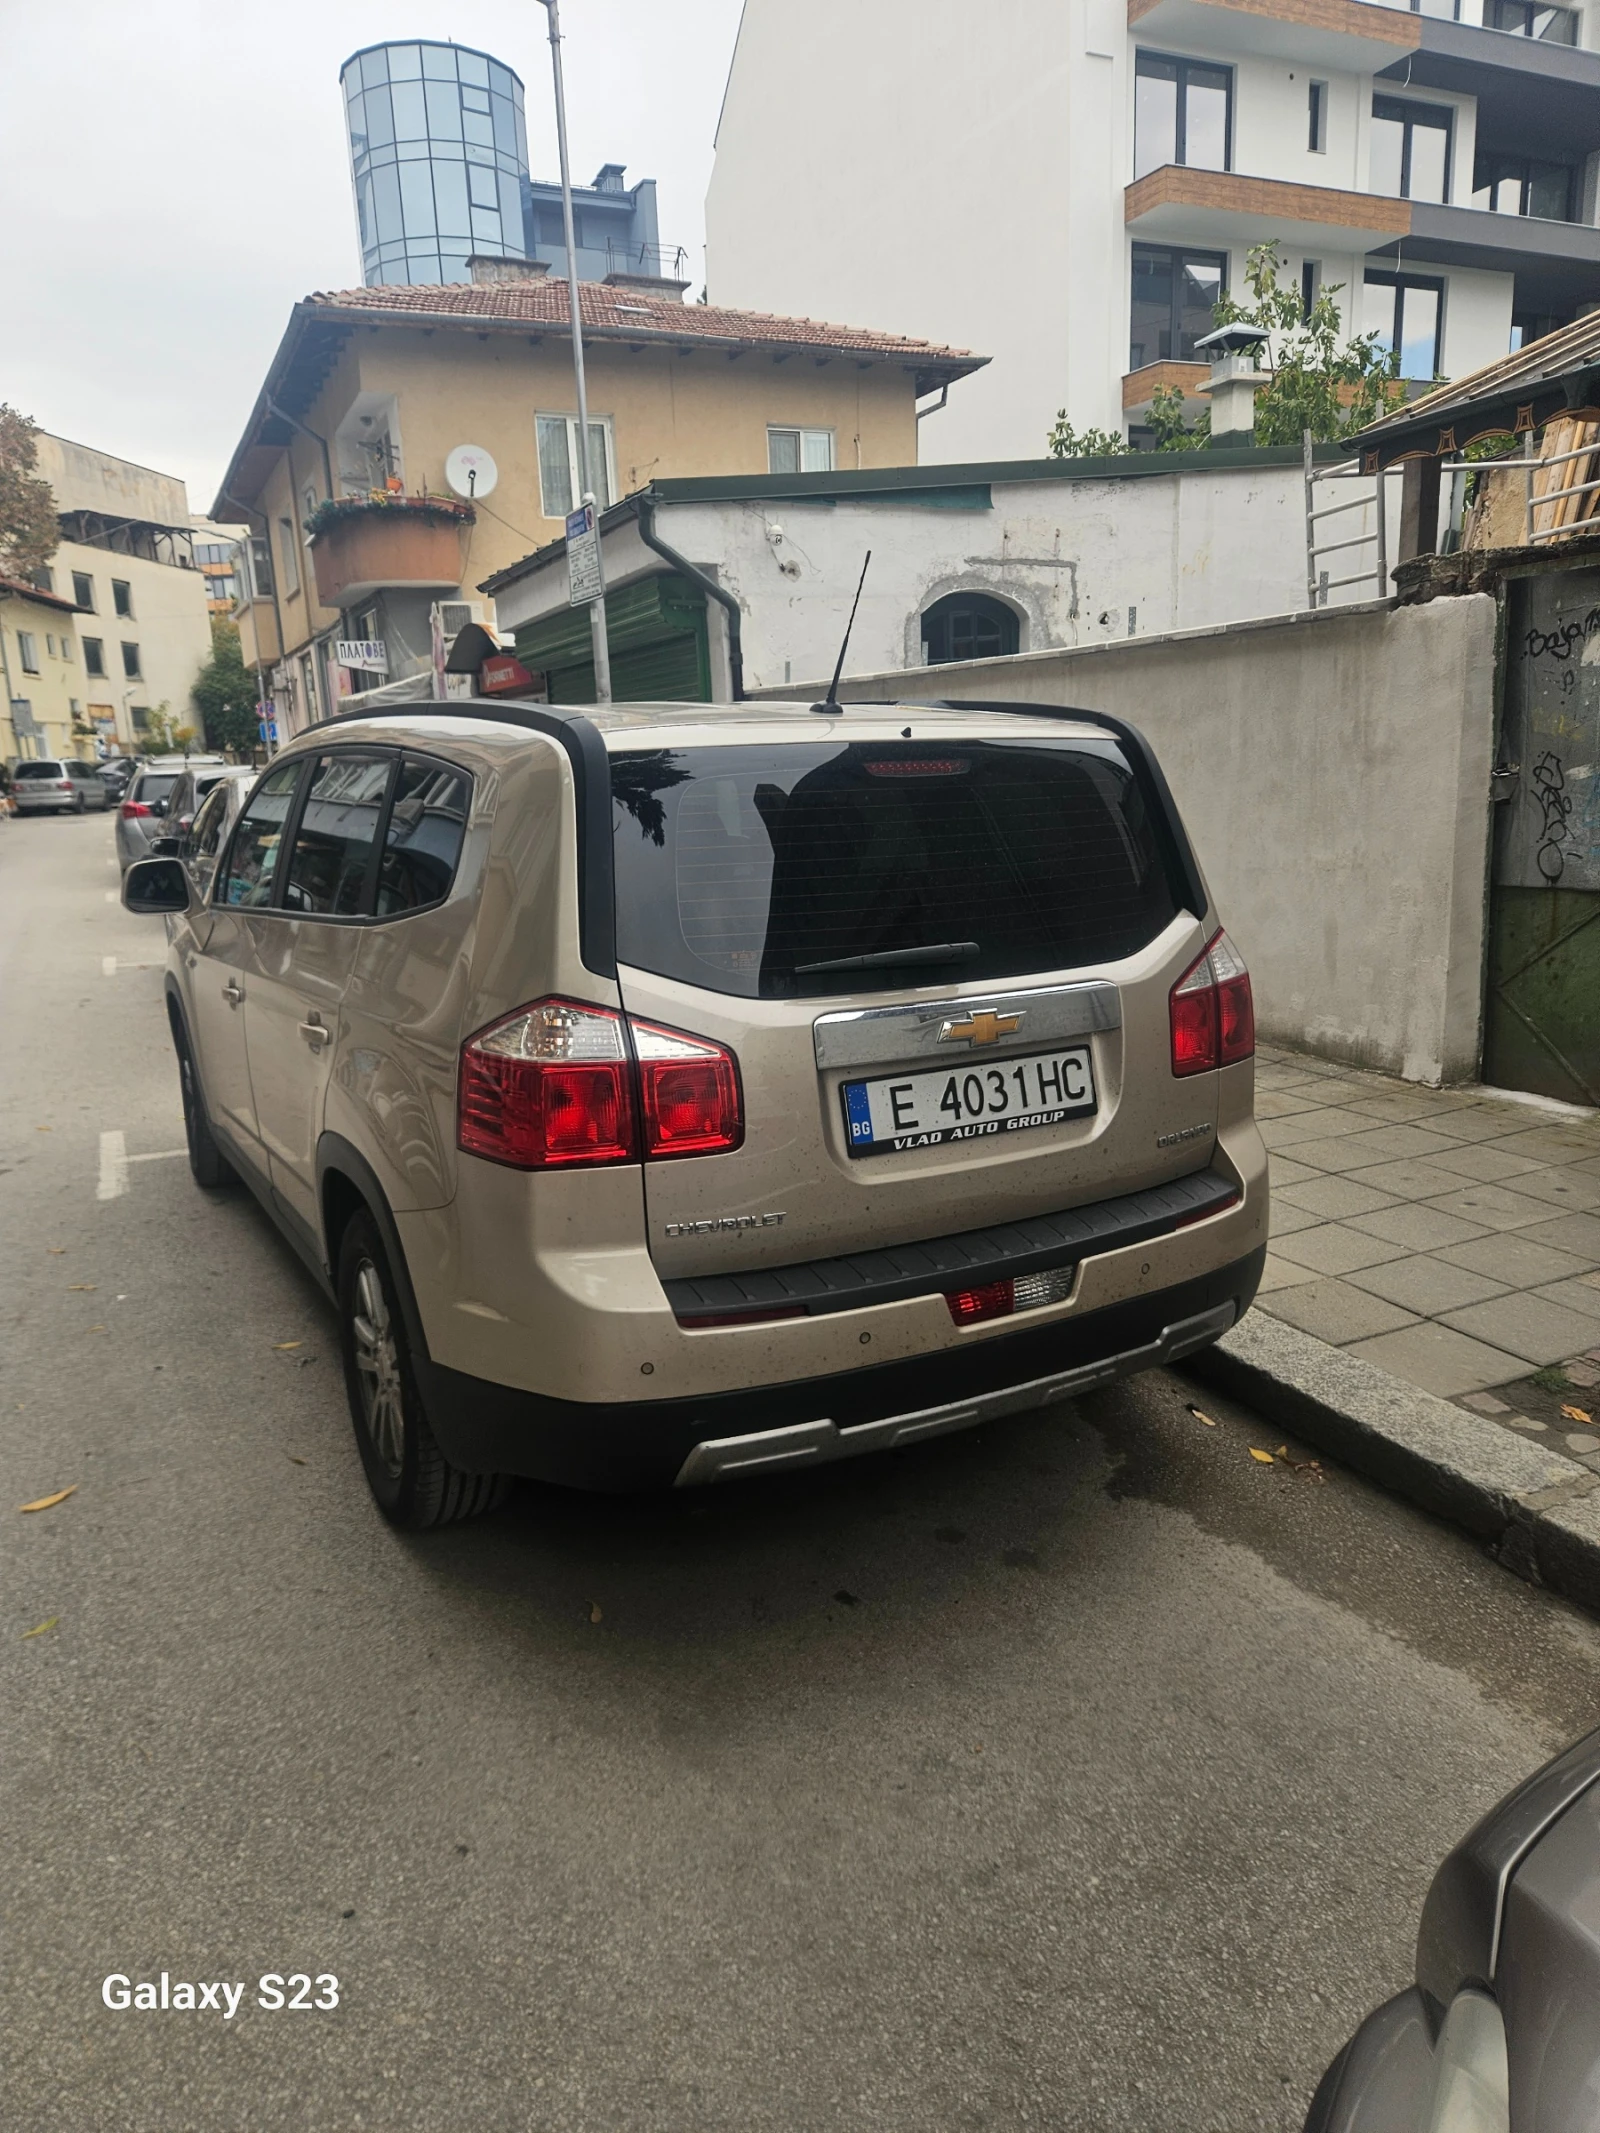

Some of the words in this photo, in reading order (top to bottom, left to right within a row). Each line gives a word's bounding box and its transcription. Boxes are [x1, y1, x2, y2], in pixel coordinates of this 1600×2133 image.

[339, 642, 385, 659] ПЛАТОВЕ
[889, 1083, 919, 1131] E
[852, 1121, 871, 1137] BG
[893, 1131, 942, 1150] VLAD
[950, 1121, 999, 1141] AUTO
[1006, 1110, 1065, 1131] GROUP
[665, 1211, 787, 1237] CHEVROLET
